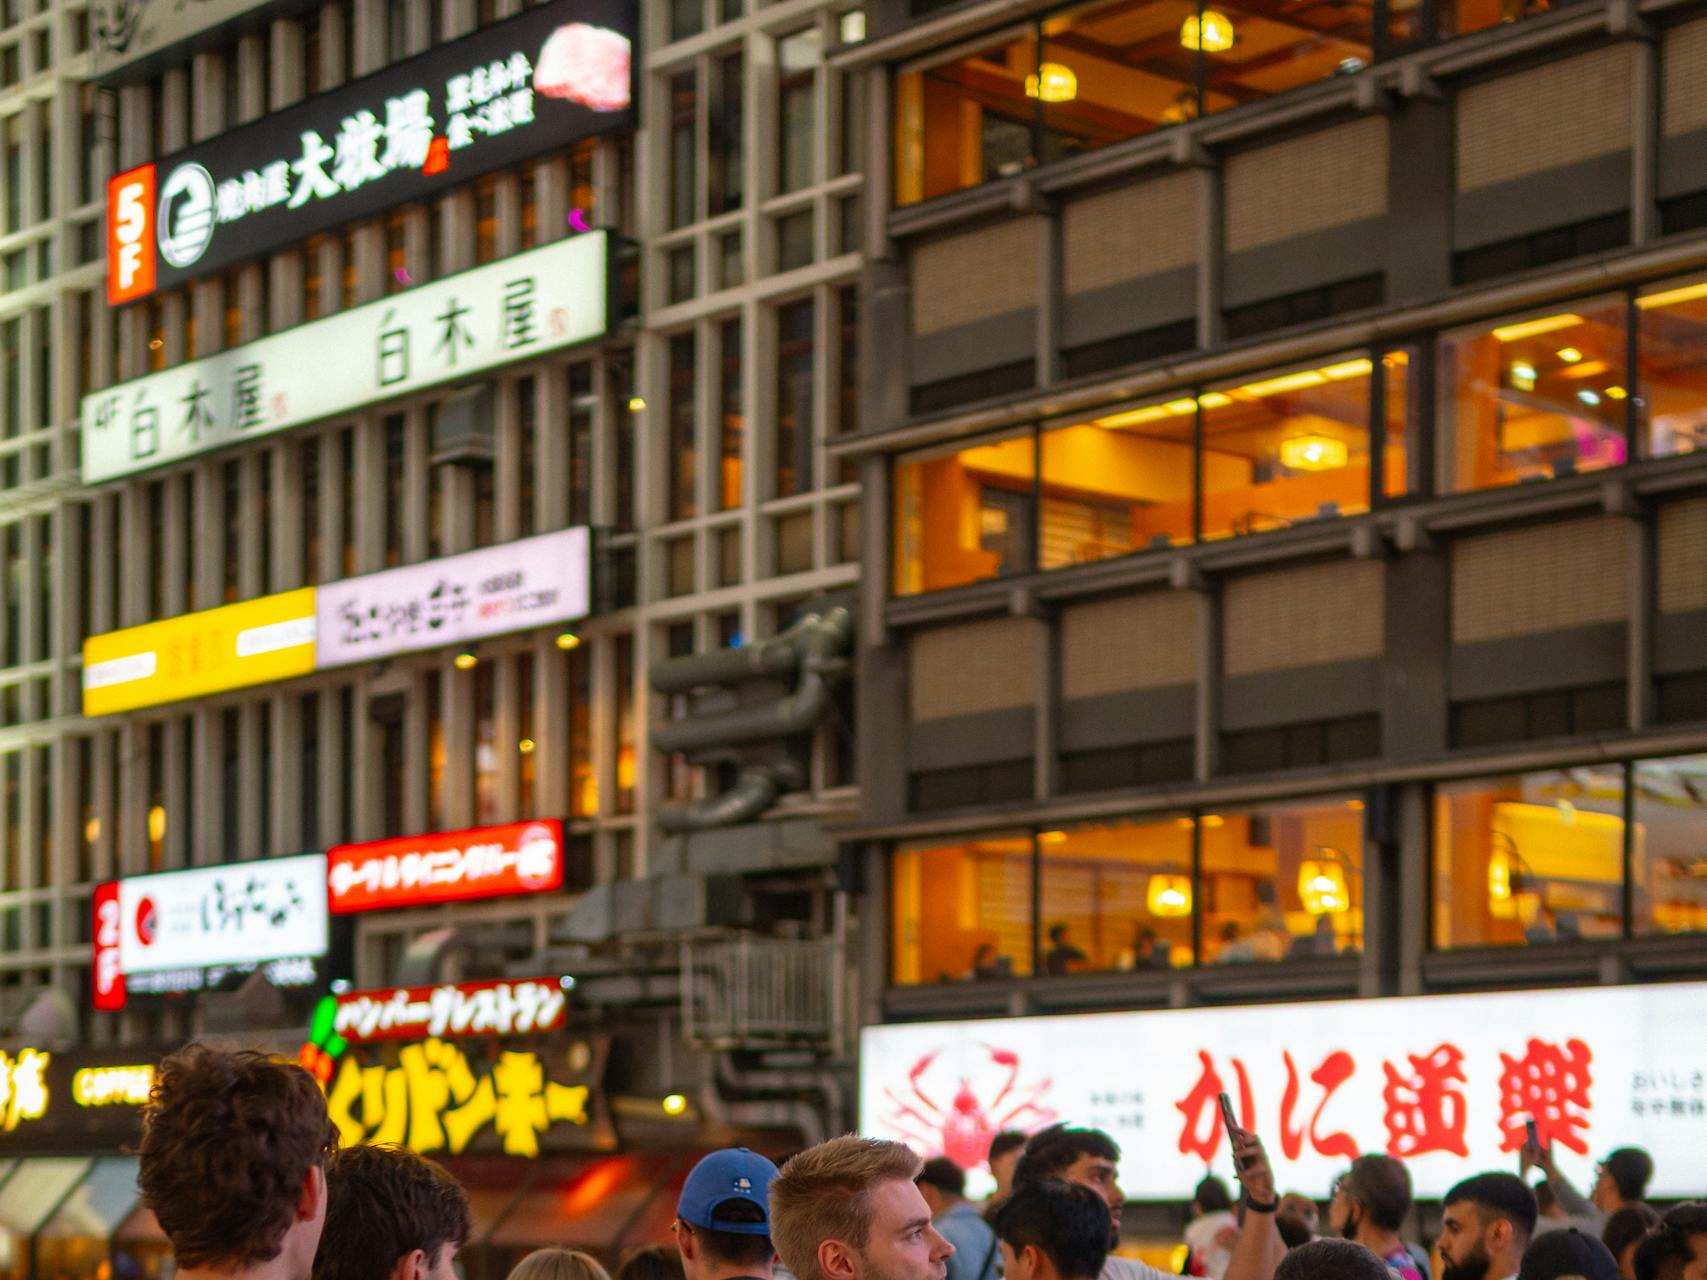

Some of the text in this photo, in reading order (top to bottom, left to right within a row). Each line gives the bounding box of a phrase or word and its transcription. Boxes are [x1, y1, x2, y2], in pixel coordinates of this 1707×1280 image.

[116, 183, 145, 289] 5F
[378, 275, 539, 388] 白木屋
[131, 363, 265, 460] 白木屋
[318, 1036, 588, 1158] くりドンキー
